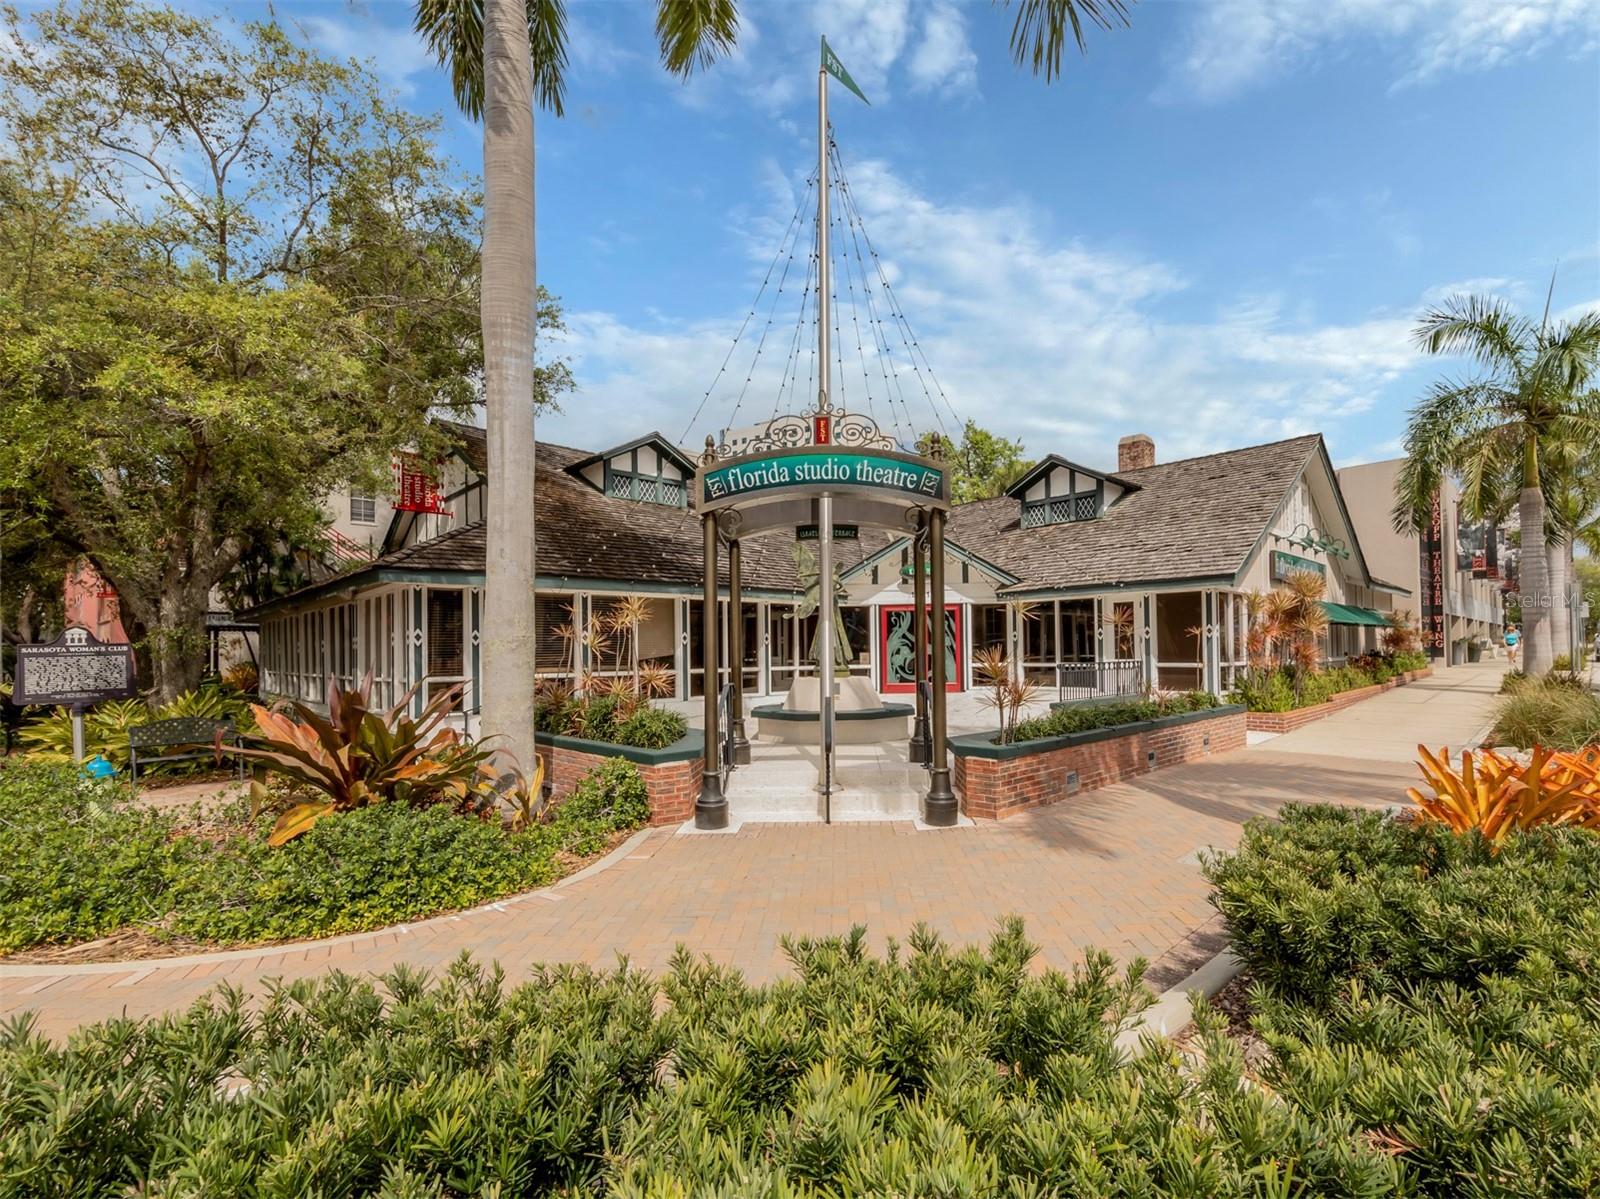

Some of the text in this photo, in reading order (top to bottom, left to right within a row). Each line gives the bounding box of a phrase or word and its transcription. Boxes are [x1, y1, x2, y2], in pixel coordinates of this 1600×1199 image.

[826, 53, 843, 78] FST
[404, 475, 412, 506] theatre
[414, 476, 424, 503] studio
[706, 458, 940, 498] FST florida studio theatre FST
[1432, 551, 1442, 606] THEATRE
[1434, 615, 1444, 648] WING
[21, 646, 67, 654] SARASOTA
